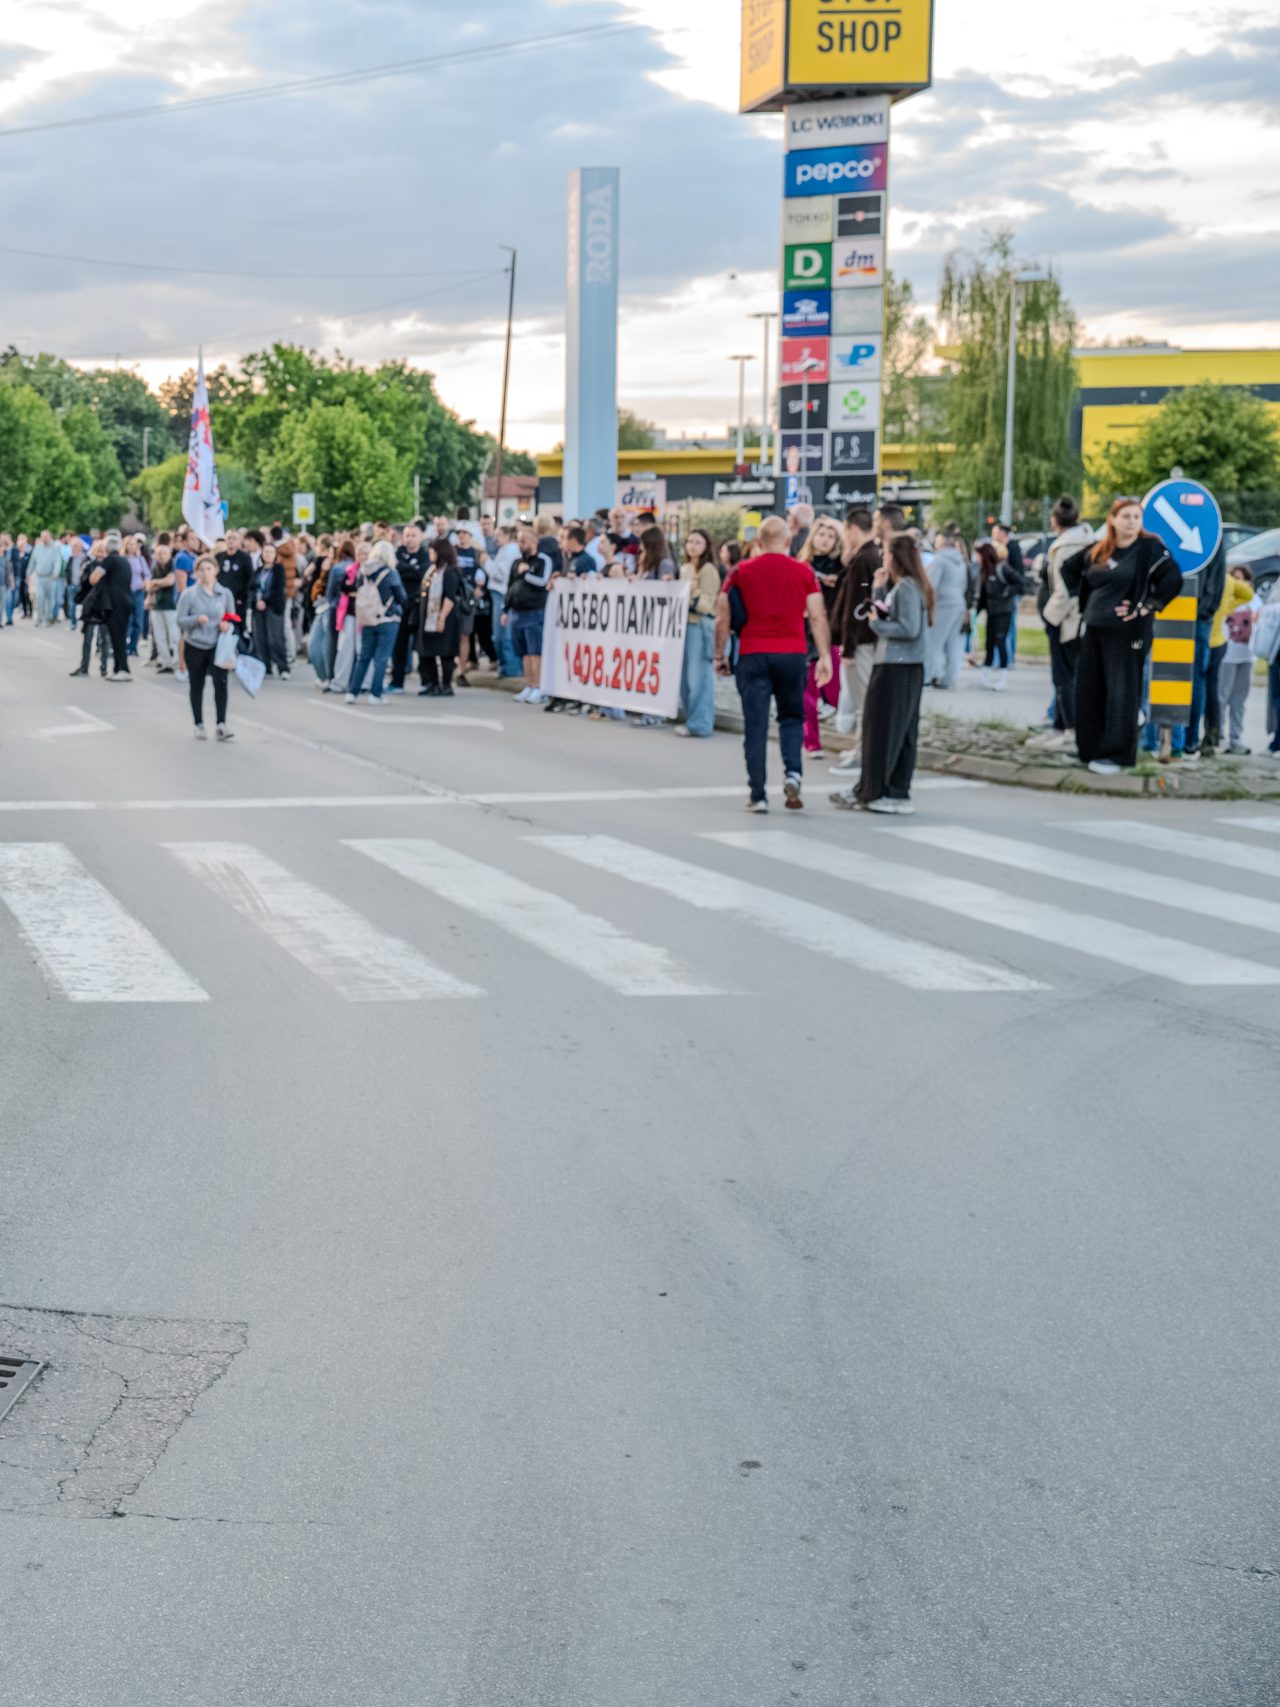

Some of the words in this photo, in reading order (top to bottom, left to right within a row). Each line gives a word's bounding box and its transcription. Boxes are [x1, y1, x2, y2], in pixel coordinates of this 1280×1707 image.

[817, 21, 901, 53] SHOP
[791, 117, 812, 133] LC
[796, 158, 875, 186] pepco
[586, 184, 612, 284] RODA
[844, 249, 874, 268] dm
